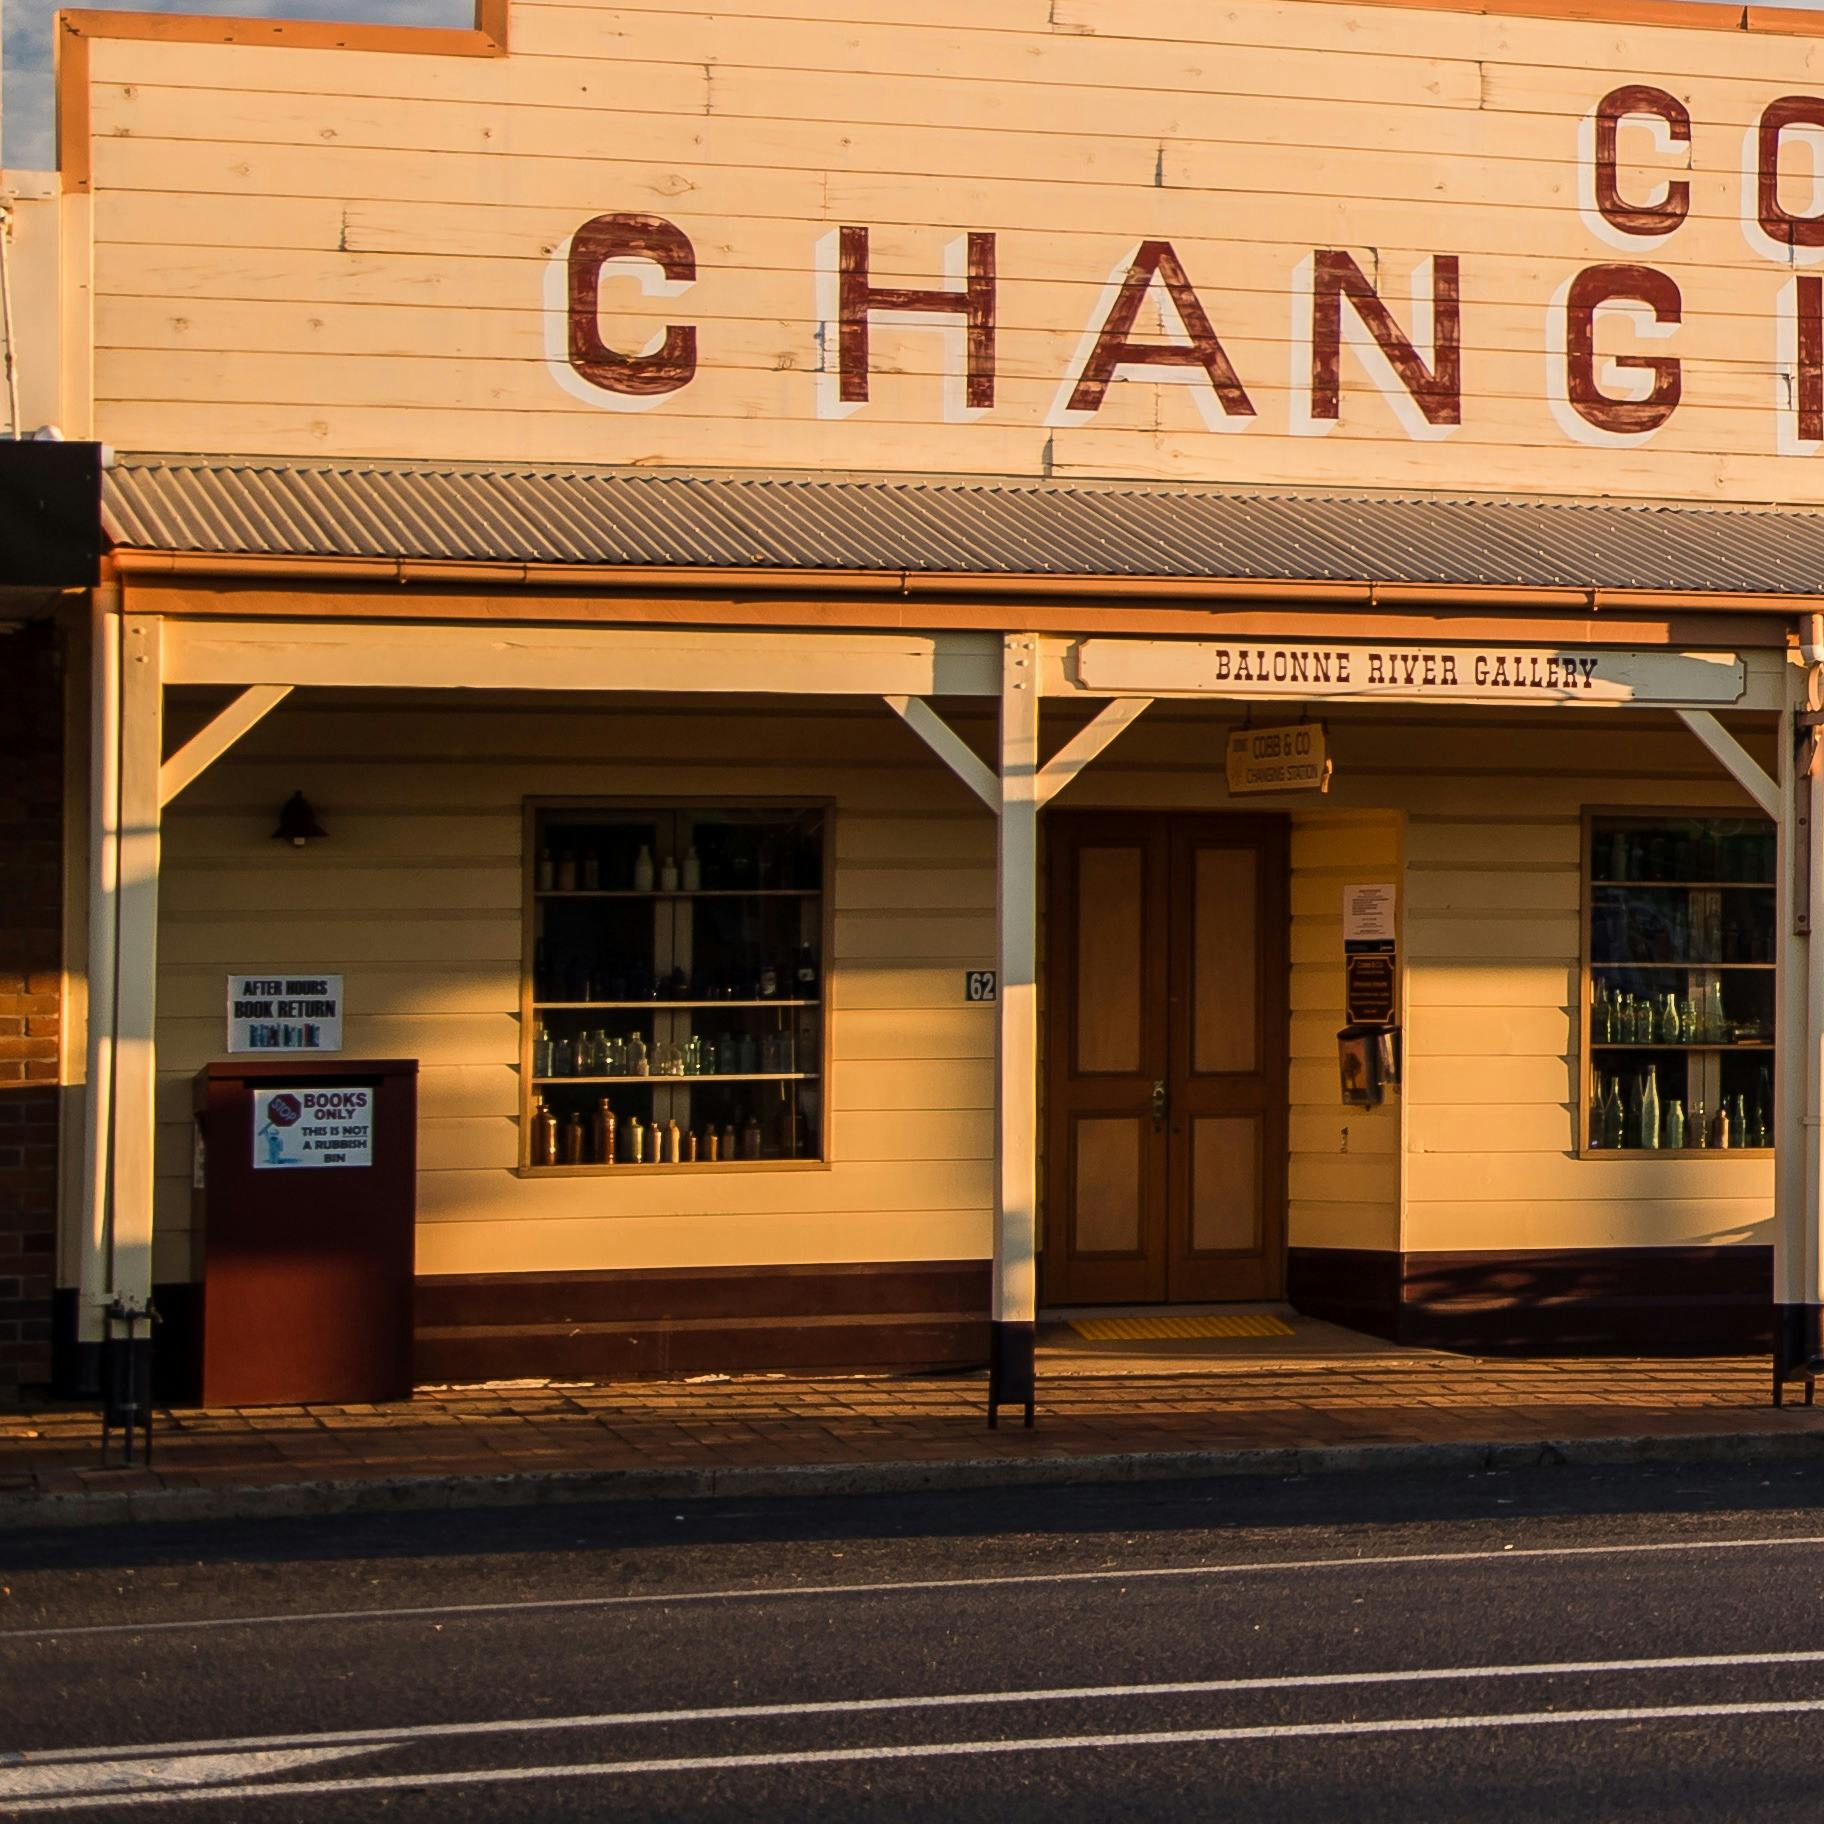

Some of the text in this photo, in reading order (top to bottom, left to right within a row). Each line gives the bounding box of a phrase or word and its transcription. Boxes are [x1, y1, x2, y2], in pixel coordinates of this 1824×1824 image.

[1215, 650, 1599, 689] BALONNE RIVER GALLERY
[1253, 735, 1281, 760] COBB
[1283, 733, 1292, 756] &
[1296, 731, 1311, 755] CO
[243, 980, 328, 996] AFTER HOURS
[971, 973, 994, 1000] 62
[234, 1000, 336, 1018] BOOK RETURN
[304, 1093, 368, 1108] BOOKS
[314, 1109, 356, 1121] ONLY
[301, 1125, 369, 1136] THIS IS NOT
[303, 1140, 367, 1150] A RUBBISH
[324, 1154, 346, 1163] BIN
